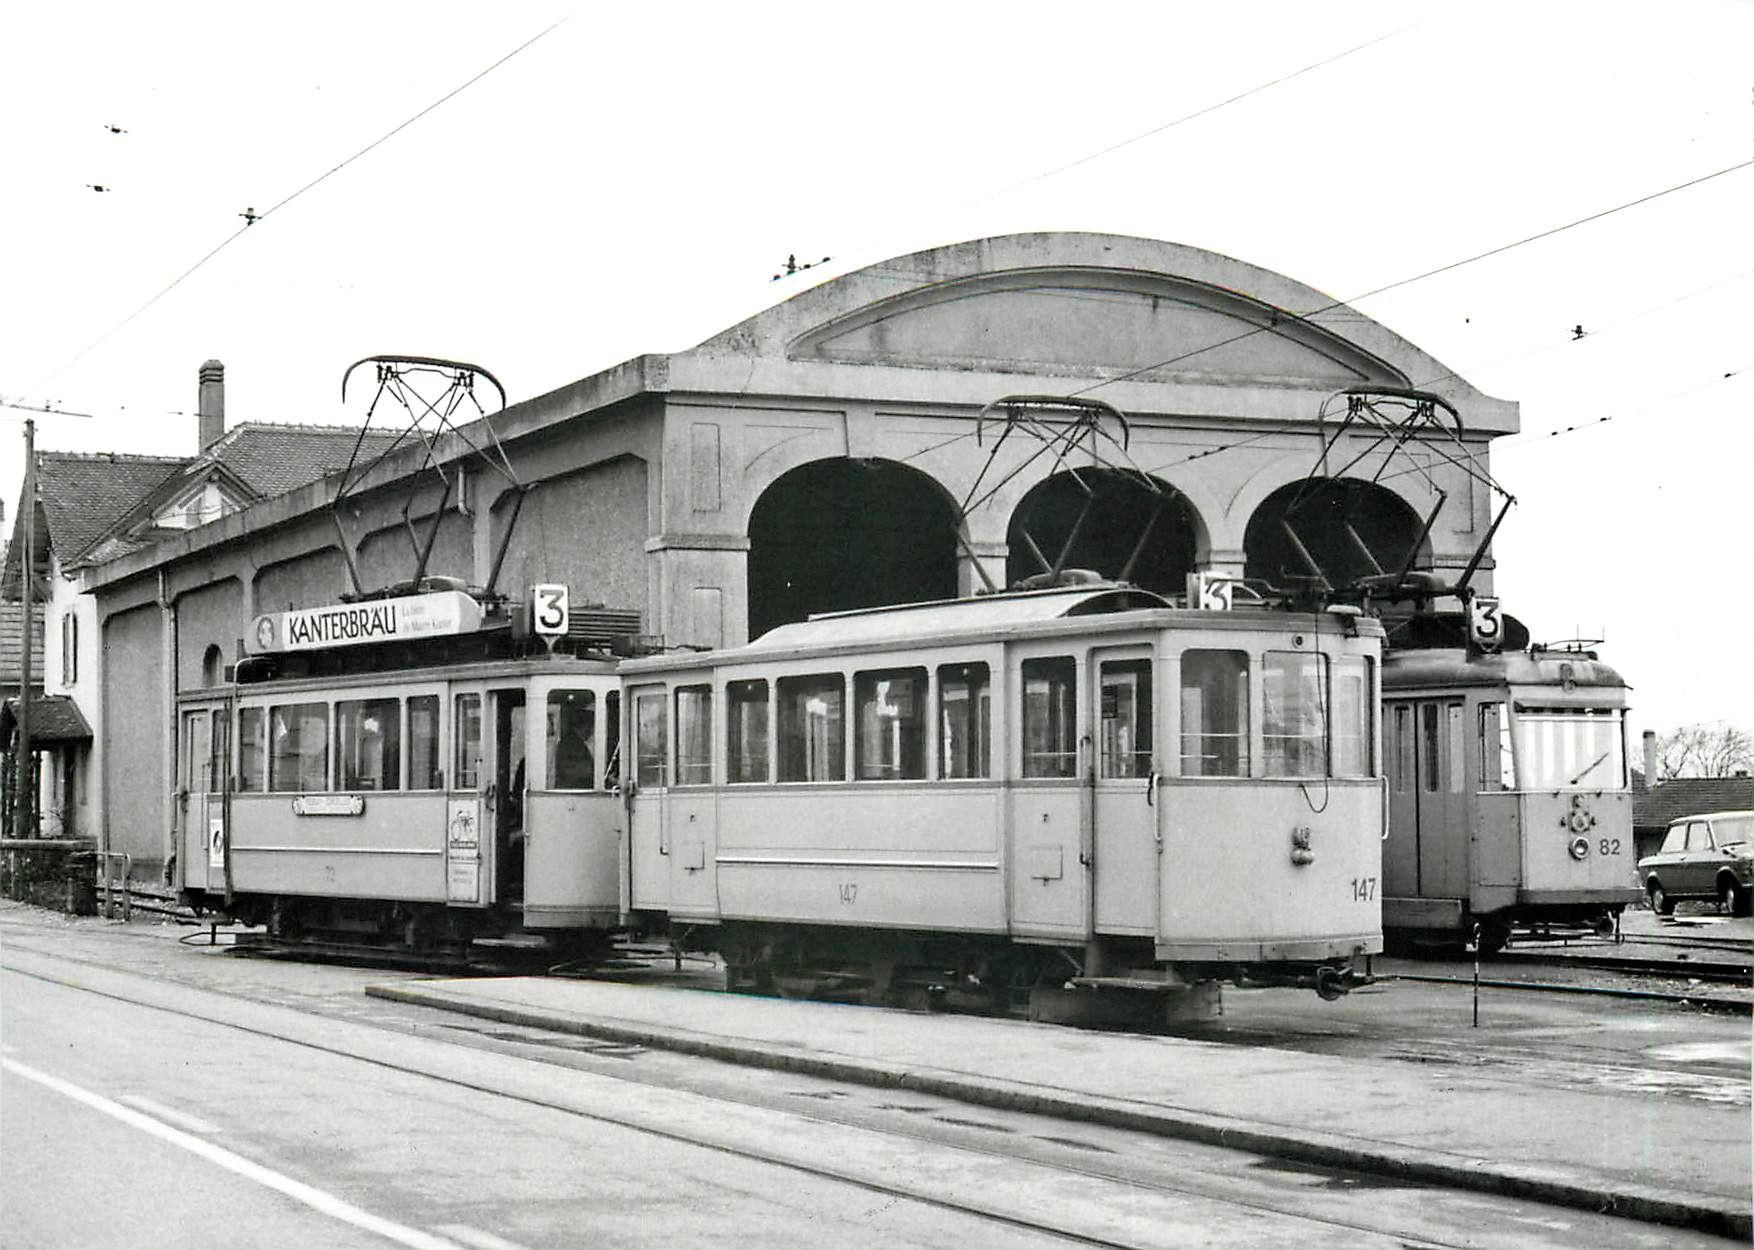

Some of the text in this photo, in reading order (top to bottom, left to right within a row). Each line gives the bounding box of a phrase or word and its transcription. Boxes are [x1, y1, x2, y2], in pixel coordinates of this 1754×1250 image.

[539, 589, 565, 629] 3
[1476, 601, 1499, 638] 3
[289, 605, 396, 645] KANTERBRÄU
[1599, 838, 1621, 856] 82
[839, 883, 858, 905] 147
[1351, 878, 1376, 902] 147
